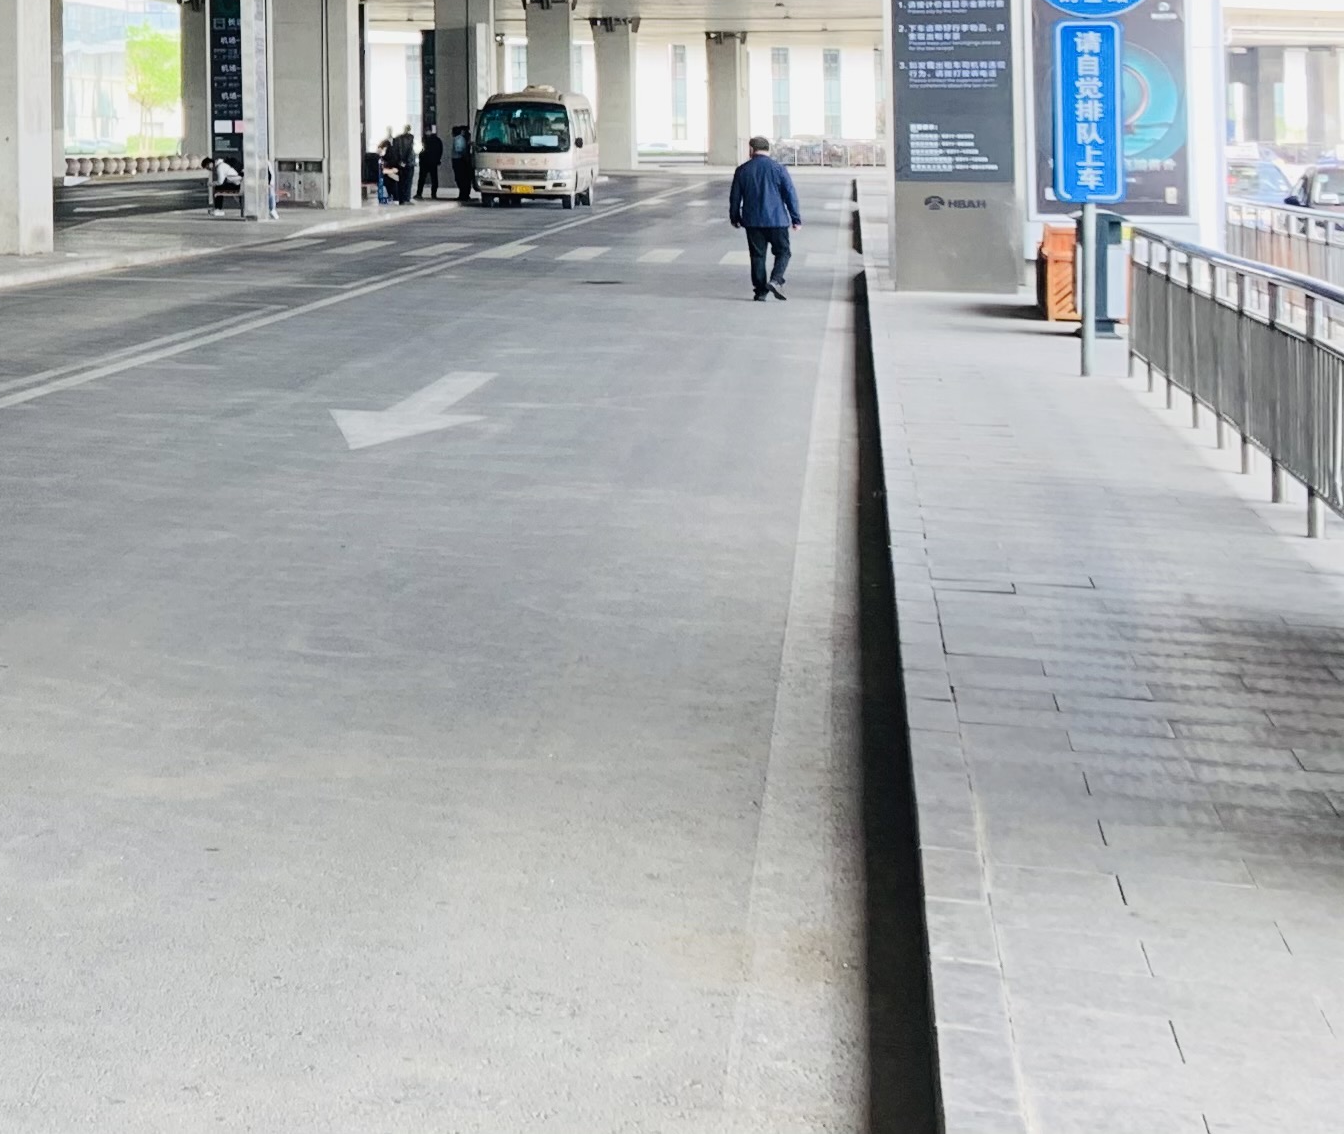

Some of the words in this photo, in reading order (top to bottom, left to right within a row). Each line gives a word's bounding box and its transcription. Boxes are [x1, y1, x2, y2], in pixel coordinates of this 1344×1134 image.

[1074, 31, 1105, 191] 请自觉排队上车
